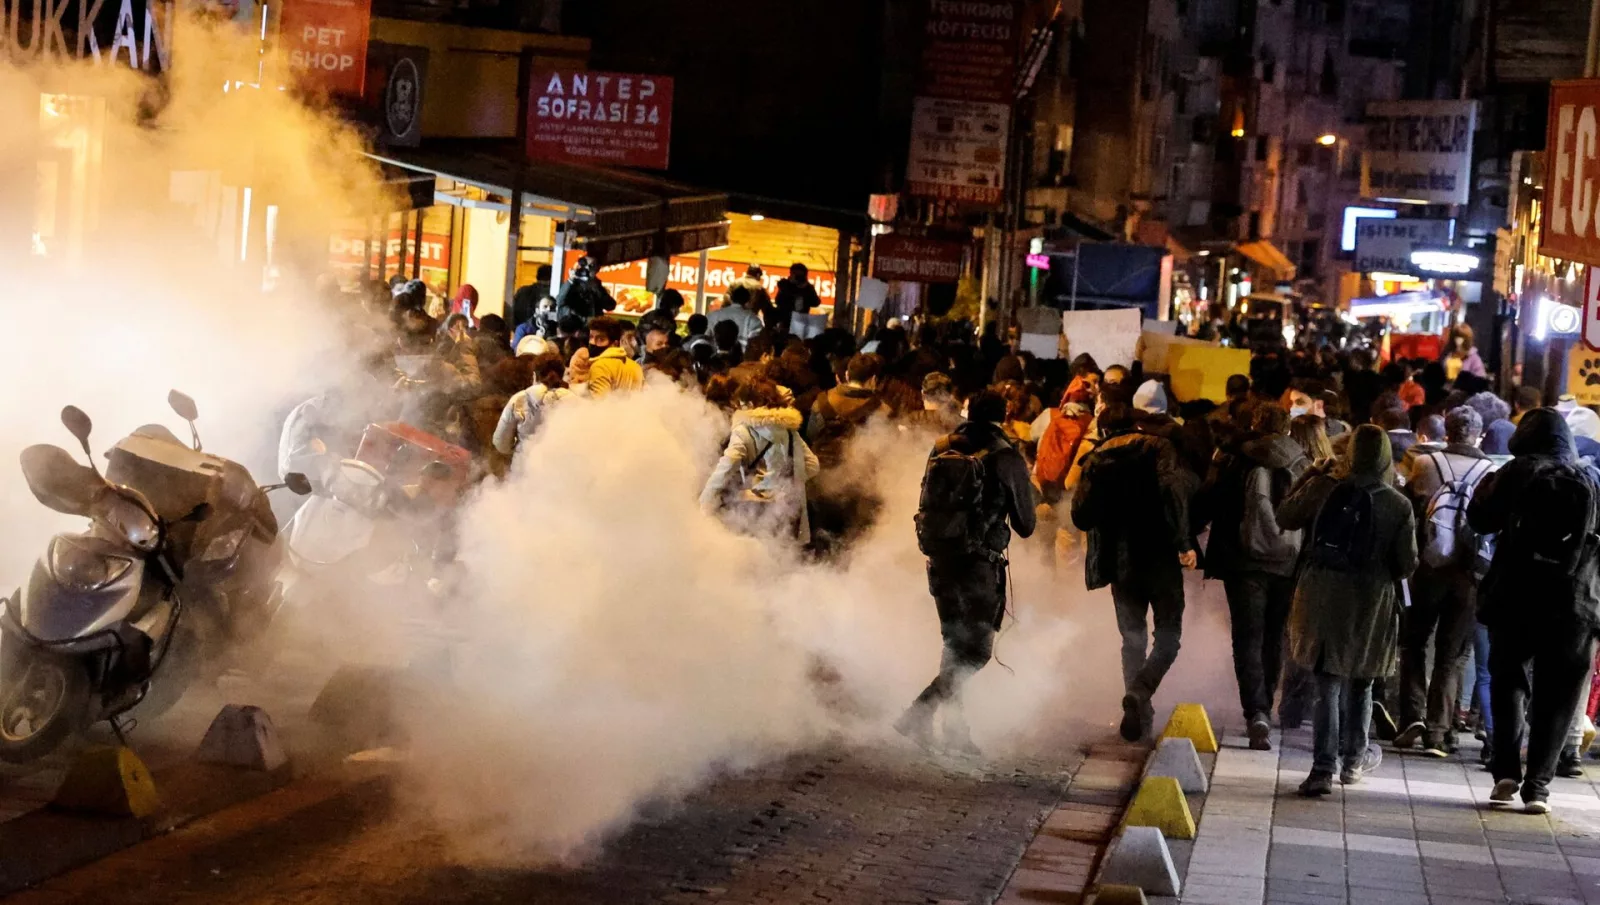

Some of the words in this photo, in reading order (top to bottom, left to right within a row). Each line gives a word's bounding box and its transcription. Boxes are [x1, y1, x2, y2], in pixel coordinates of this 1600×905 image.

[303, 26, 346, 48] PET
[290, 49, 354, 71] SHOP
[546, 72, 656, 100] ANTEP
[634, 104, 660, 125] 34
[1551, 104, 1600, 239] EC
